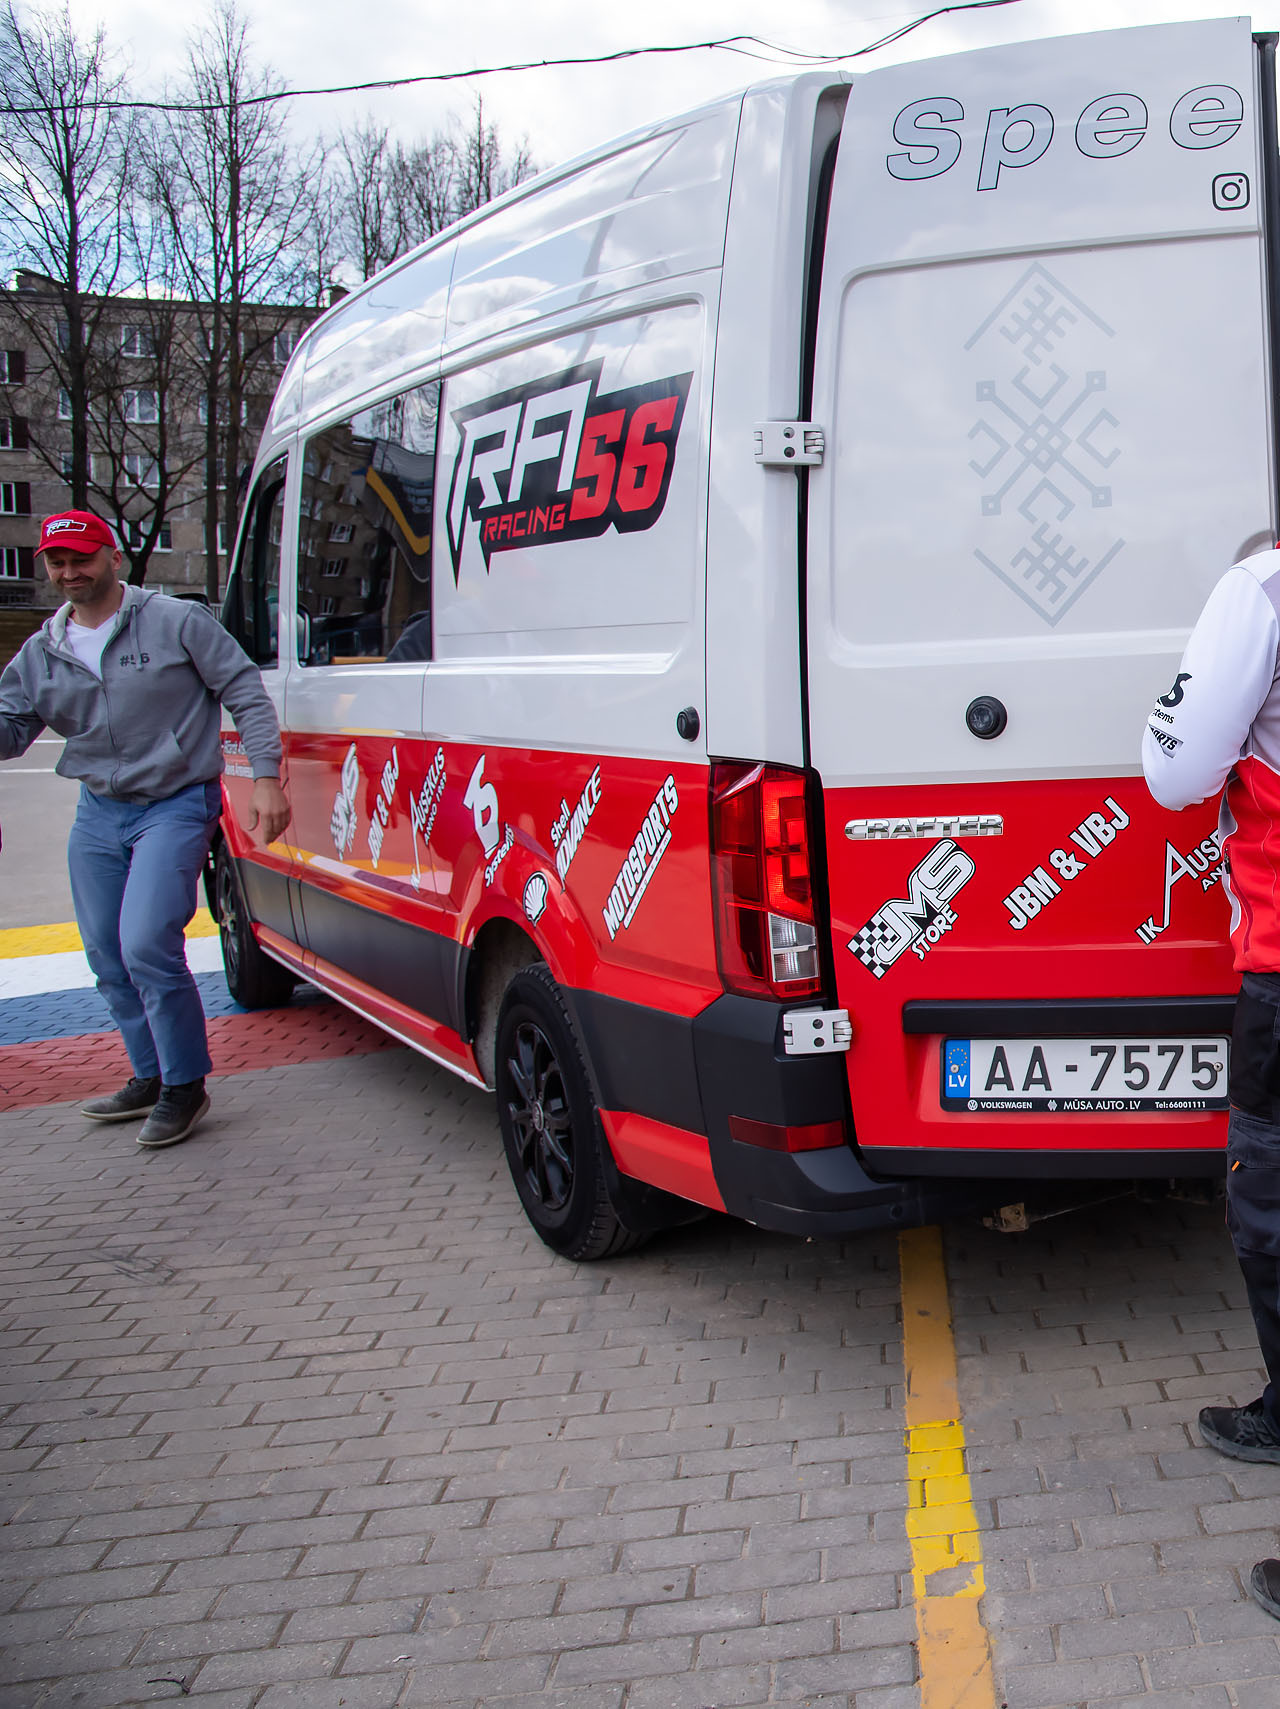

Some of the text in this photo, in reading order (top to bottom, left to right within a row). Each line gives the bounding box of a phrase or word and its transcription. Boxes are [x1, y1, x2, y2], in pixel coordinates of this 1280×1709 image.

[483, 504, 566, 543] RACING
[409, 745, 445, 879] AUSEKLIS
[551, 797, 571, 849] Shell
[555, 763, 602, 894] ADVANCE
[845, 815, 1003, 840] CRAFTER
[602, 774, 679, 942] MOTOSPORTS
[1002, 795, 1131, 930] JBM & VBJ
[874, 838, 976, 965] JMS
[911, 903, 959, 961] STORE
[1135, 916, 1165, 945] IK
[949, 1075, 967, 1088] LV
[980, 1101, 1033, 1110] VOLKSWAGEN
[1155, 1101, 1207, 1110] Tel:66001111
